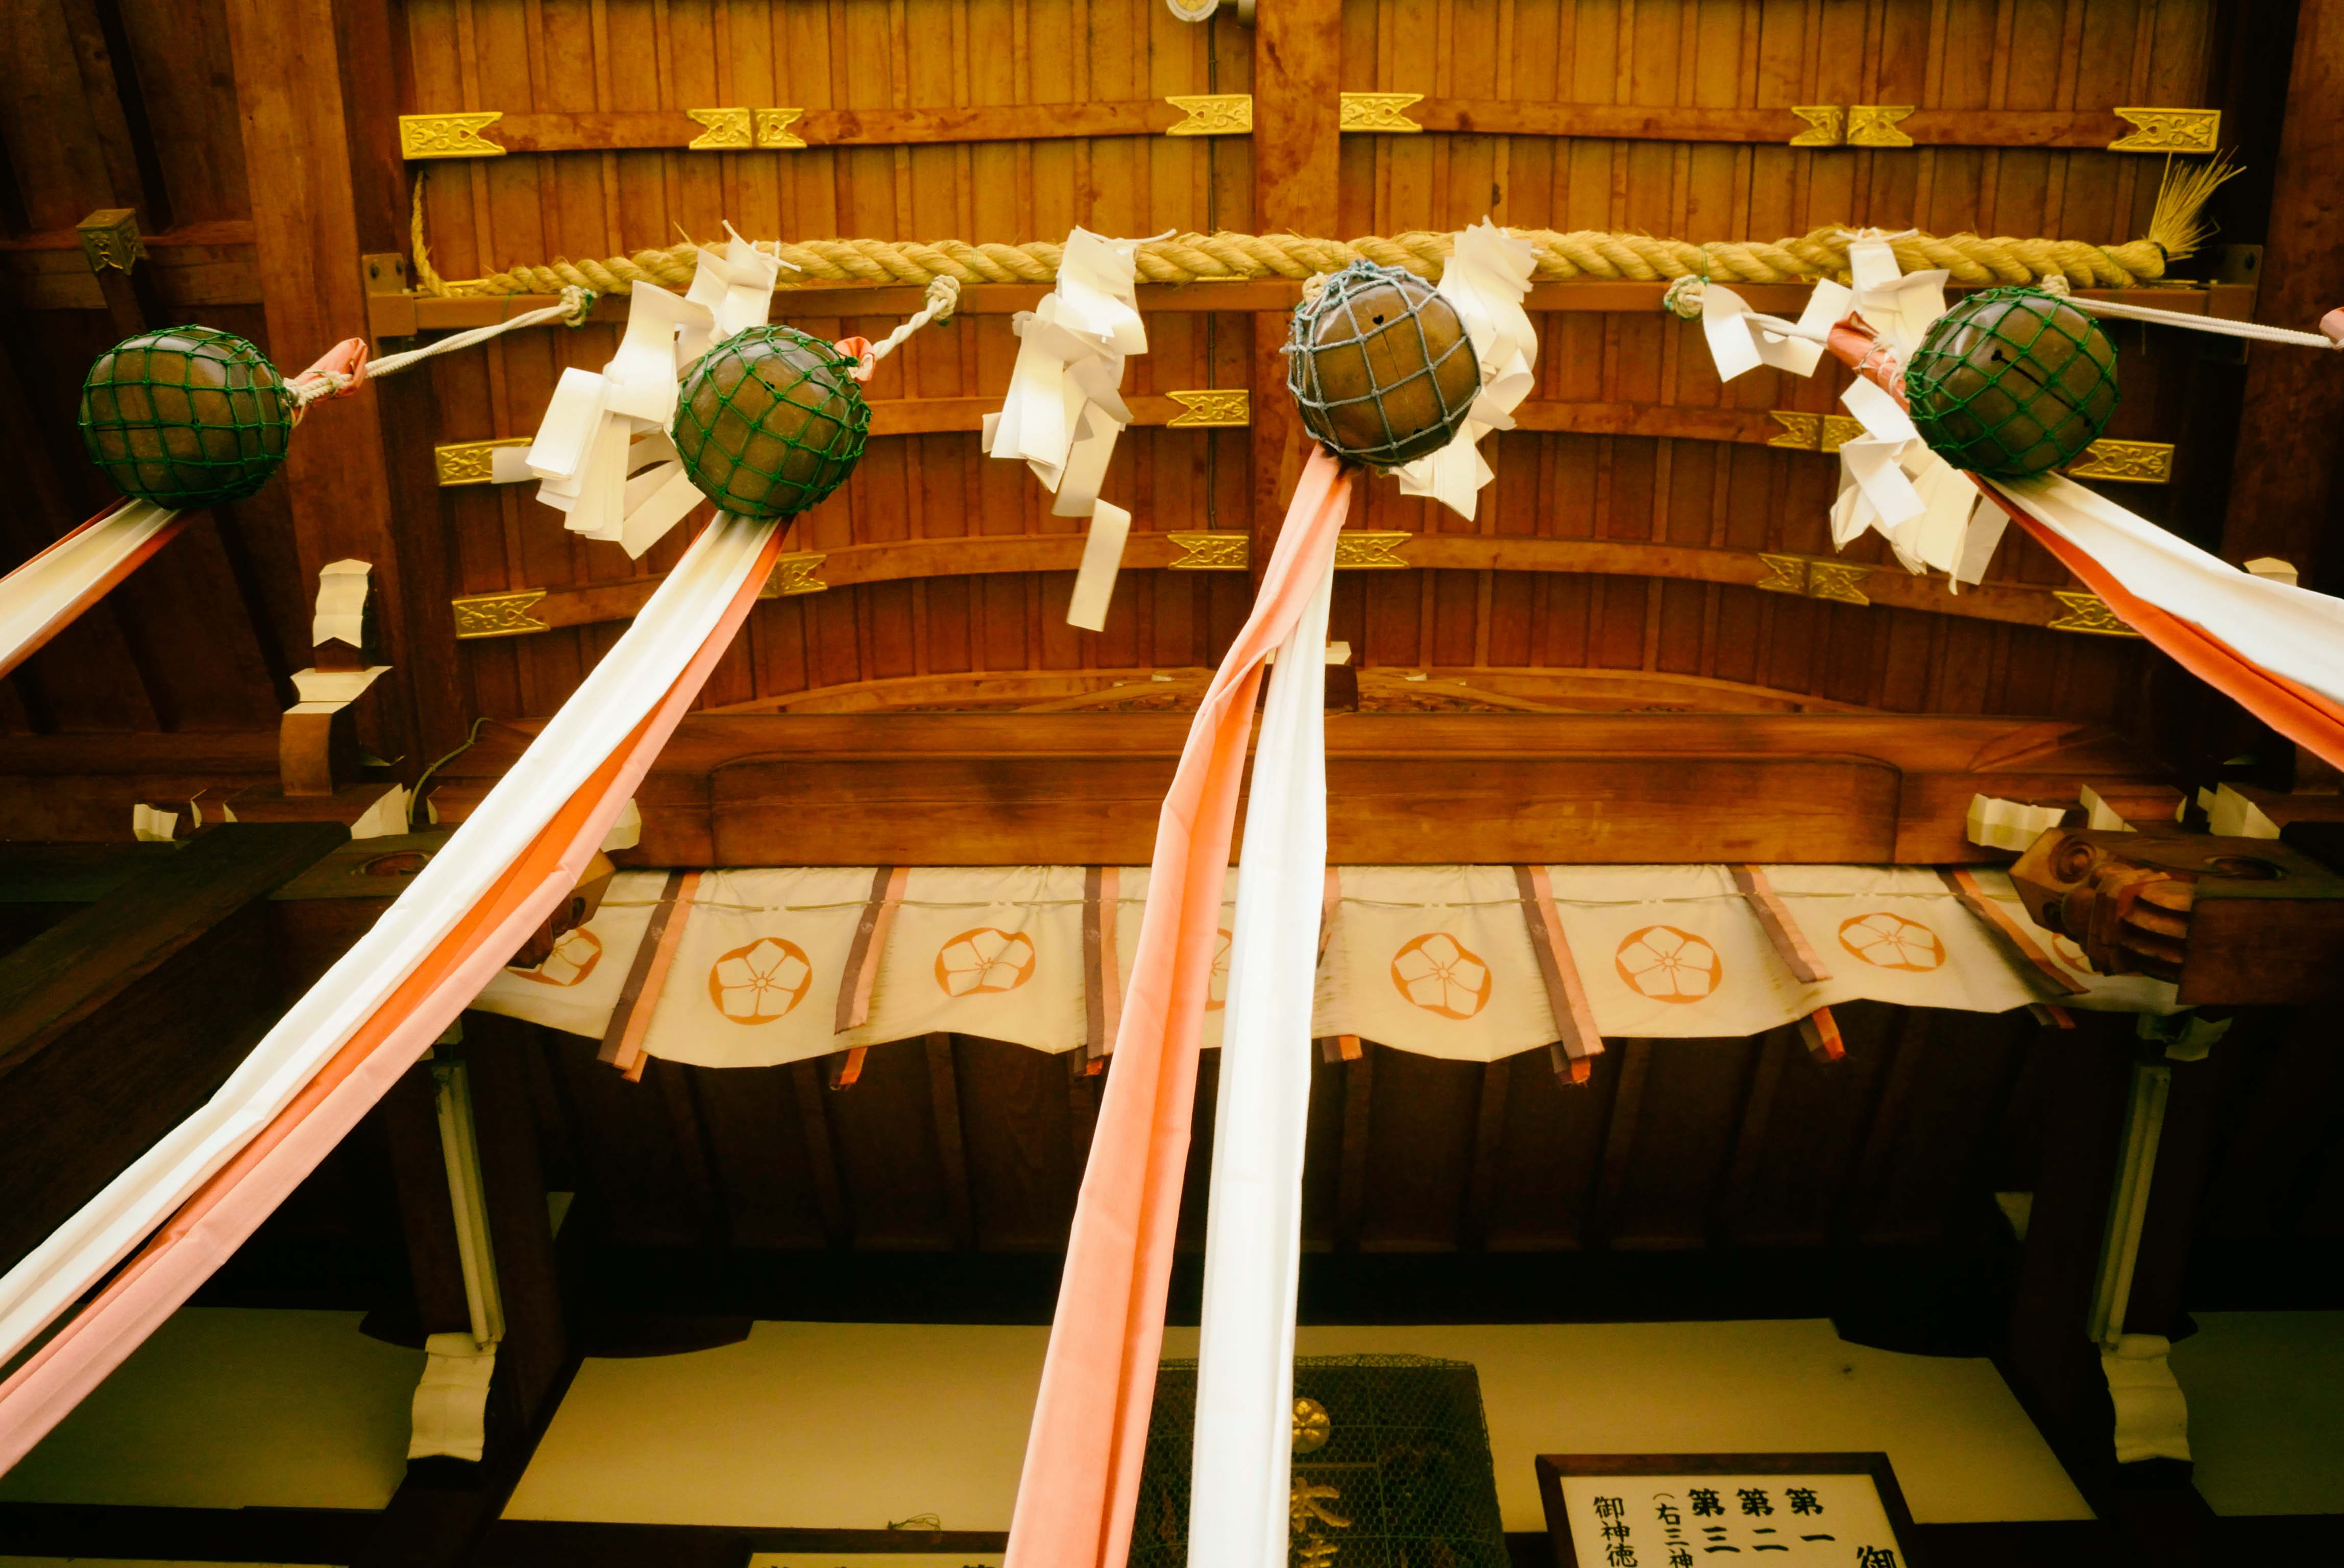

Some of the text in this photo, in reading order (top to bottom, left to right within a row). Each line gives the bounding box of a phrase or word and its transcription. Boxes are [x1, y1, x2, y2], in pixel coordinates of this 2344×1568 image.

[1593, 1496, 1638, 1568] 御神徳
[1688, 1487, 1741, 1554] 第三
[1736, 1487, 1789, 1552] 第二
[1785, 1487, 1836, 1542] 第一
